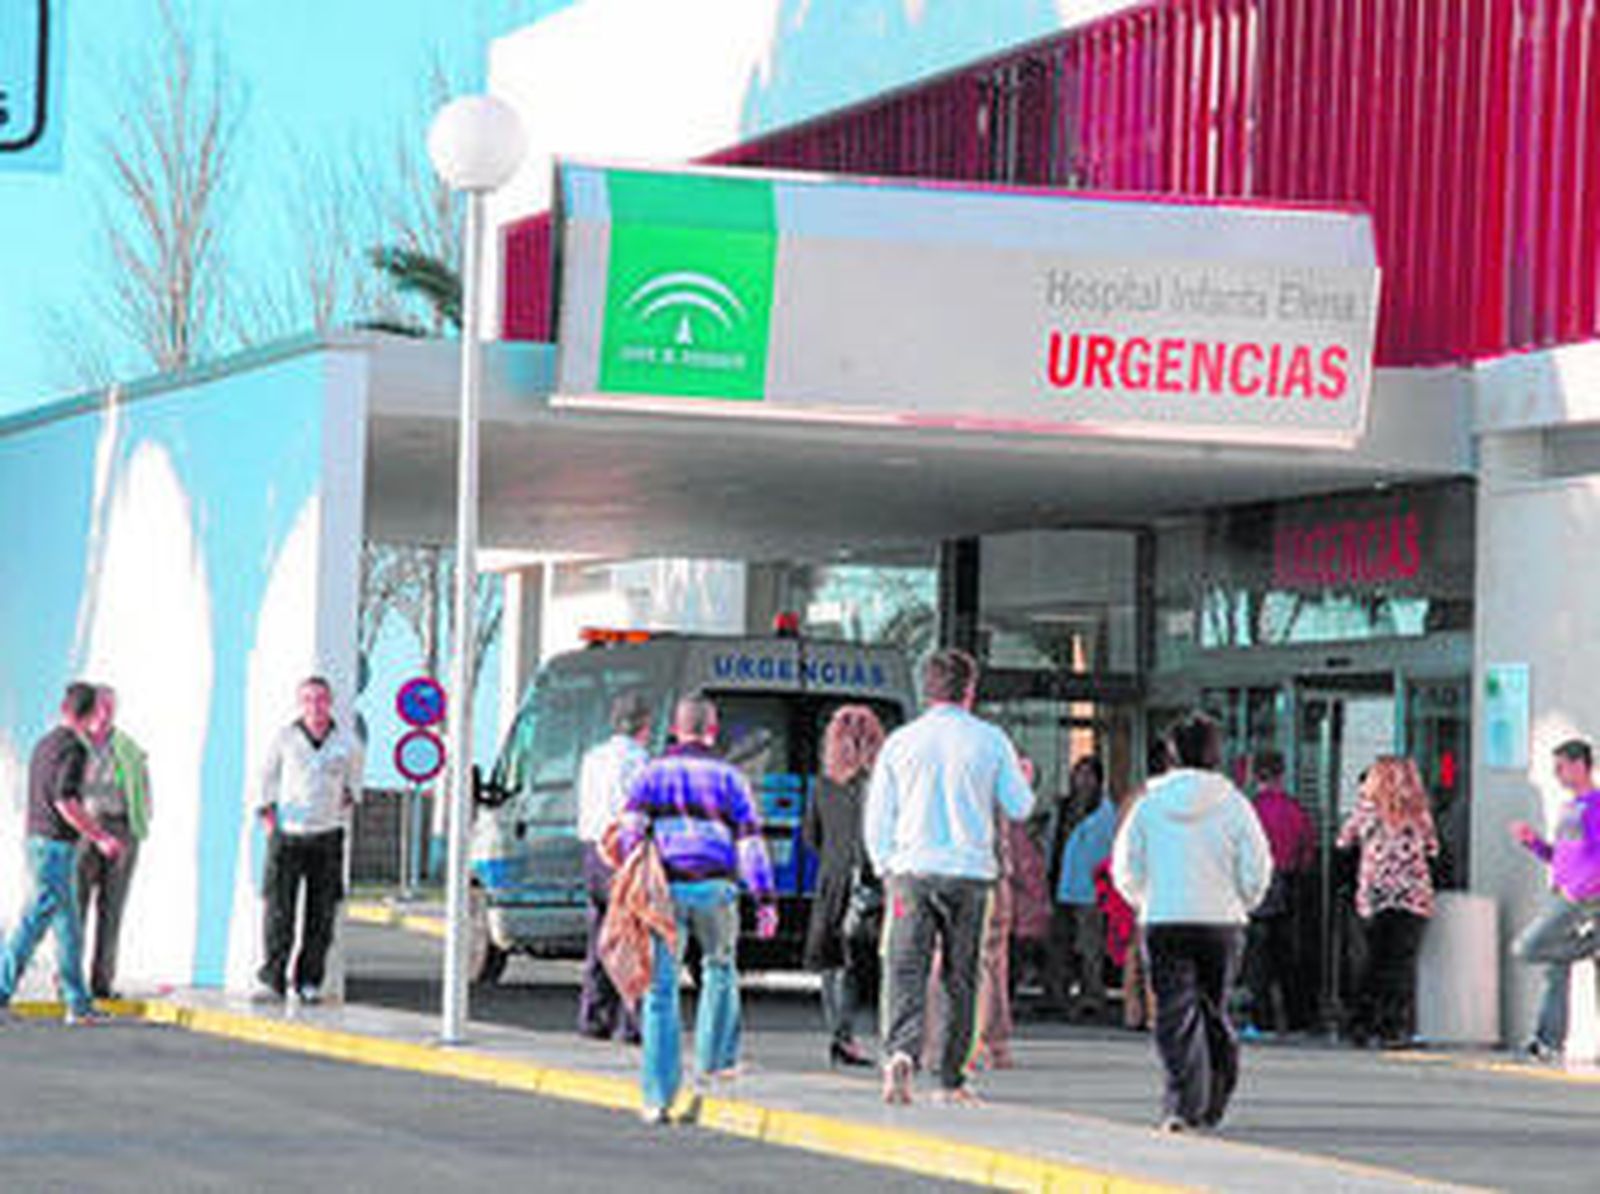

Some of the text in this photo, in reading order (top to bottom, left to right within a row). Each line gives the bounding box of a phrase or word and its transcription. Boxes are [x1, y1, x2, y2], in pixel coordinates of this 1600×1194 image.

[1047, 268, 1162, 314] Hospital
[1047, 329, 1349, 400] URGENCIAS
[714, 655, 886, 688] URGENCIAS
